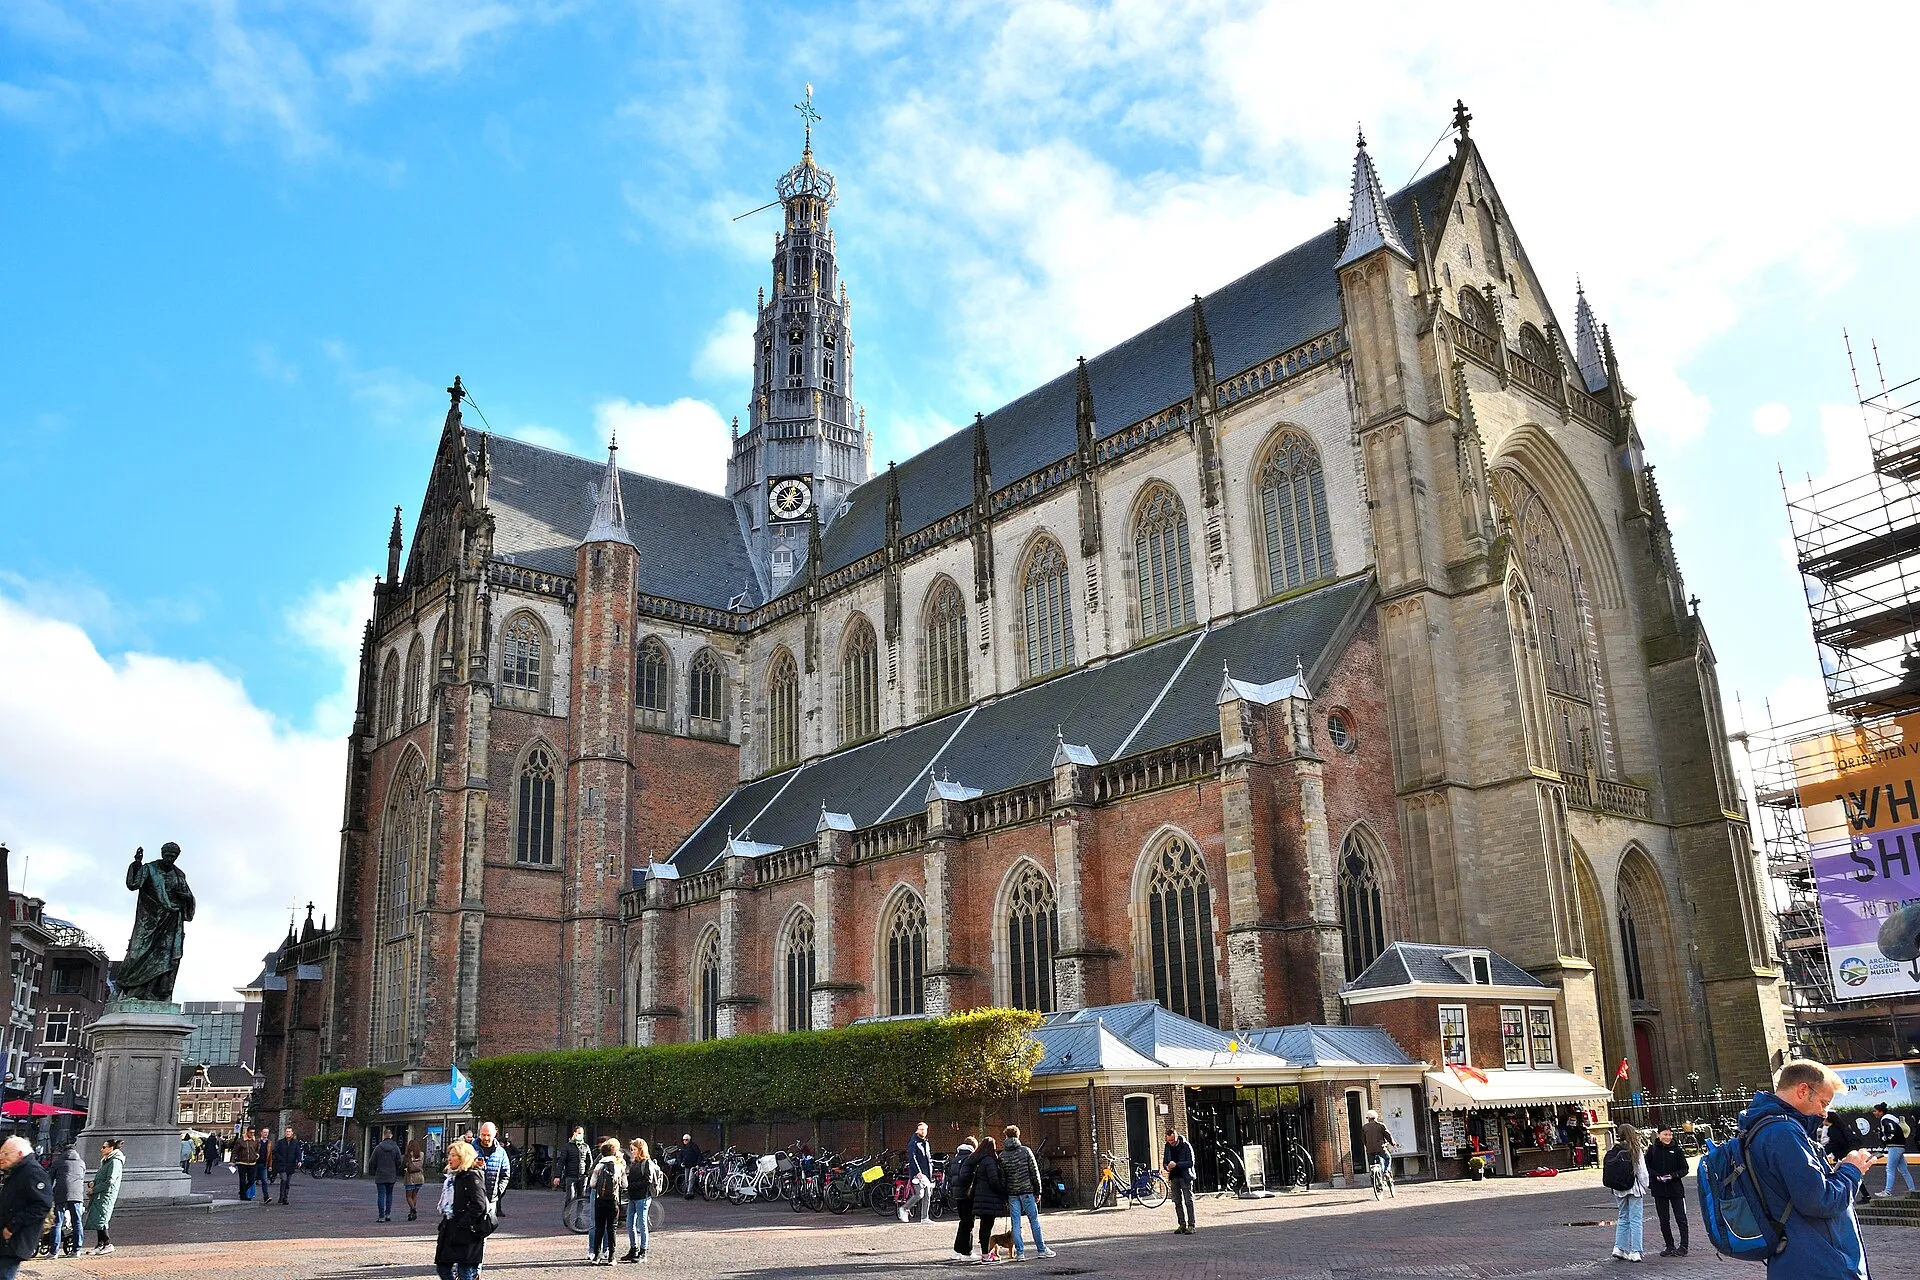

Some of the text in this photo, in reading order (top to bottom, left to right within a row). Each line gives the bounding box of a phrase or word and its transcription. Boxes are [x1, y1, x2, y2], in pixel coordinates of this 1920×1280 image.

[1869, 962, 1900, 970] LOGISCH
[1870, 967, 1901, 976] MUSEUM
[1842, 1076, 1890, 1085] EOLOGISCH
